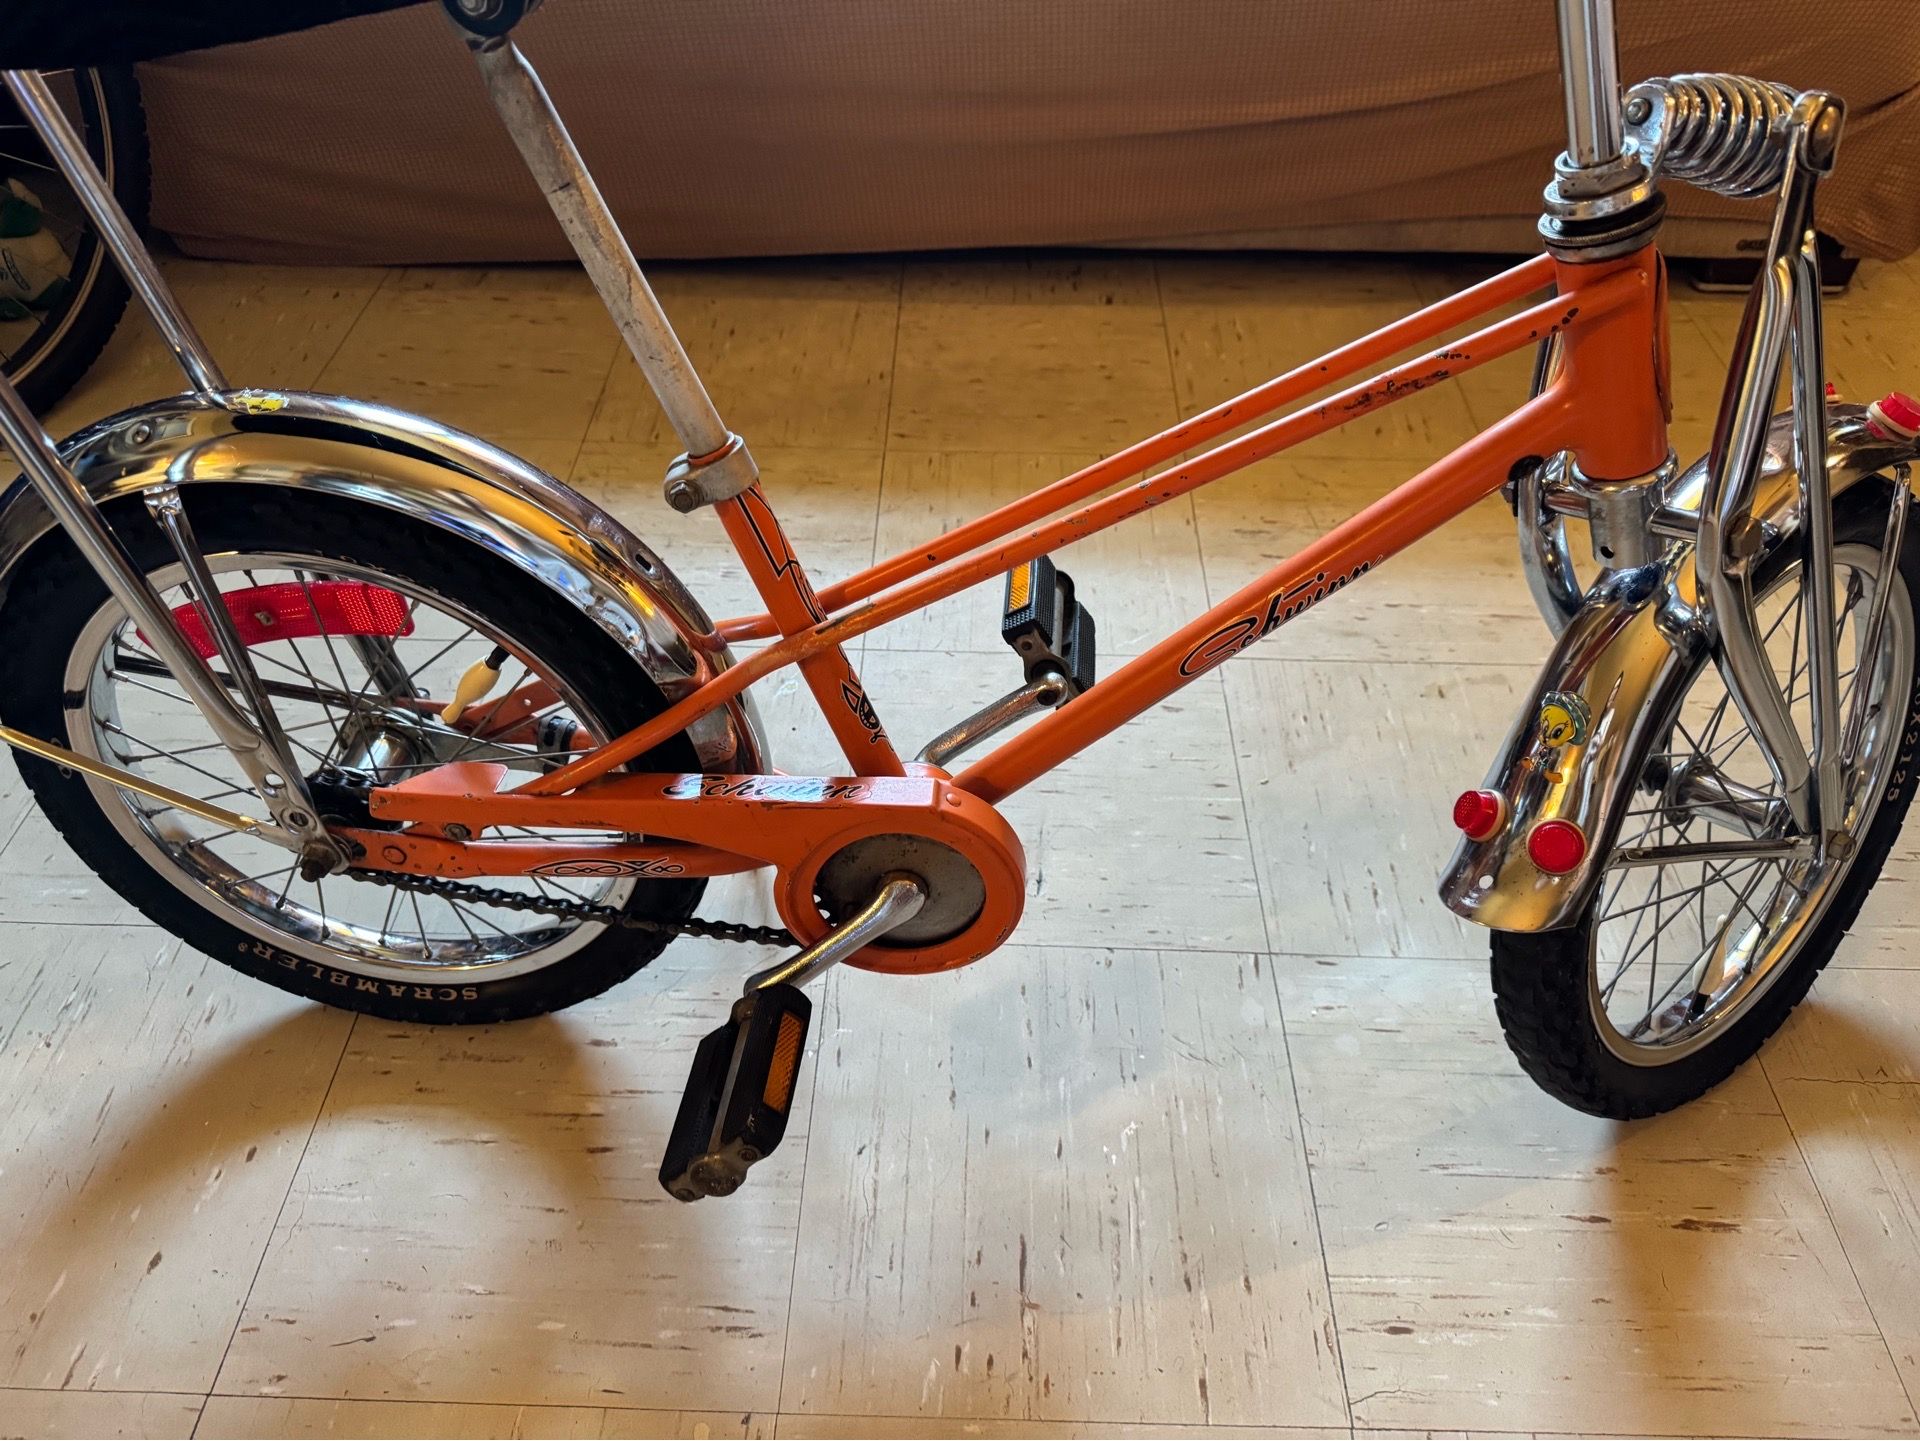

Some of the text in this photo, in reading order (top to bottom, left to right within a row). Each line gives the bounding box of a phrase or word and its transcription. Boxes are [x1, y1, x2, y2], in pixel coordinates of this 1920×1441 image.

[1178, 555, 1383, 677] Schwinn
[662, 774, 870, 800] Schwinn
[253, 942, 478, 1001] SCRAMBLER
